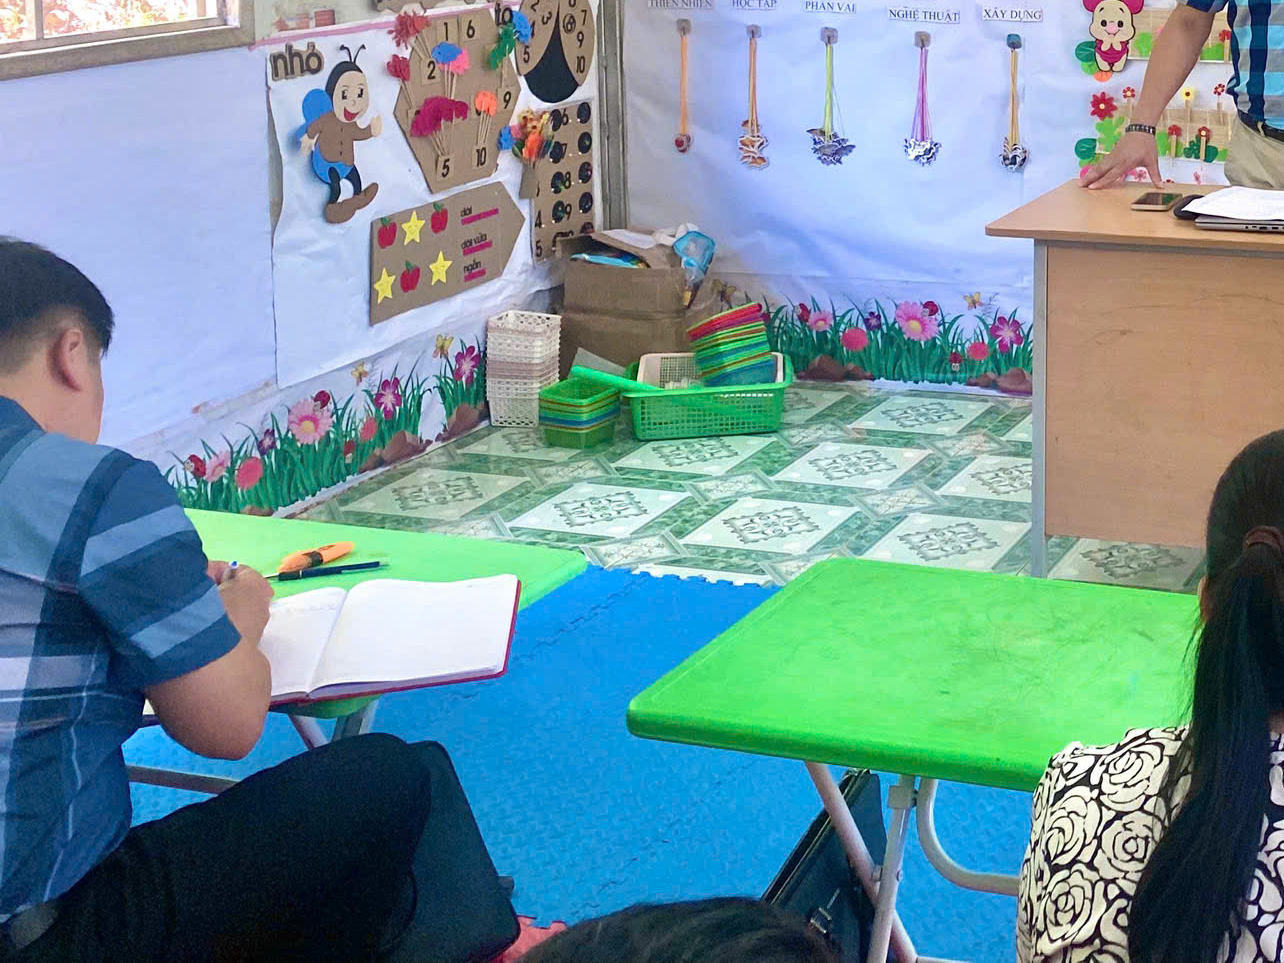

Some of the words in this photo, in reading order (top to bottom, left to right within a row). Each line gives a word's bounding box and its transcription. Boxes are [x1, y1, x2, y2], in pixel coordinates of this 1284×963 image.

[542, 11, 552, 25] 3
[581, 10, 587, 26] 7
[443, 22, 449, 41] 1
[466, 19, 475, 38] 6
[576, 31, 585, 48] 9
[523, 45, 530, 63] 5
[427, 60, 436, 80] 2
[576, 56, 586, 73] 10
[503, 91, 512, 109] 9
[476, 147, 487, 168] 10
[441, 158, 450, 178] 5
[564, 171, 571, 189] 8
[535, 210, 542, 228] 4
[565, 203, 572, 221] 9
[535, 240, 543, 257] 5
